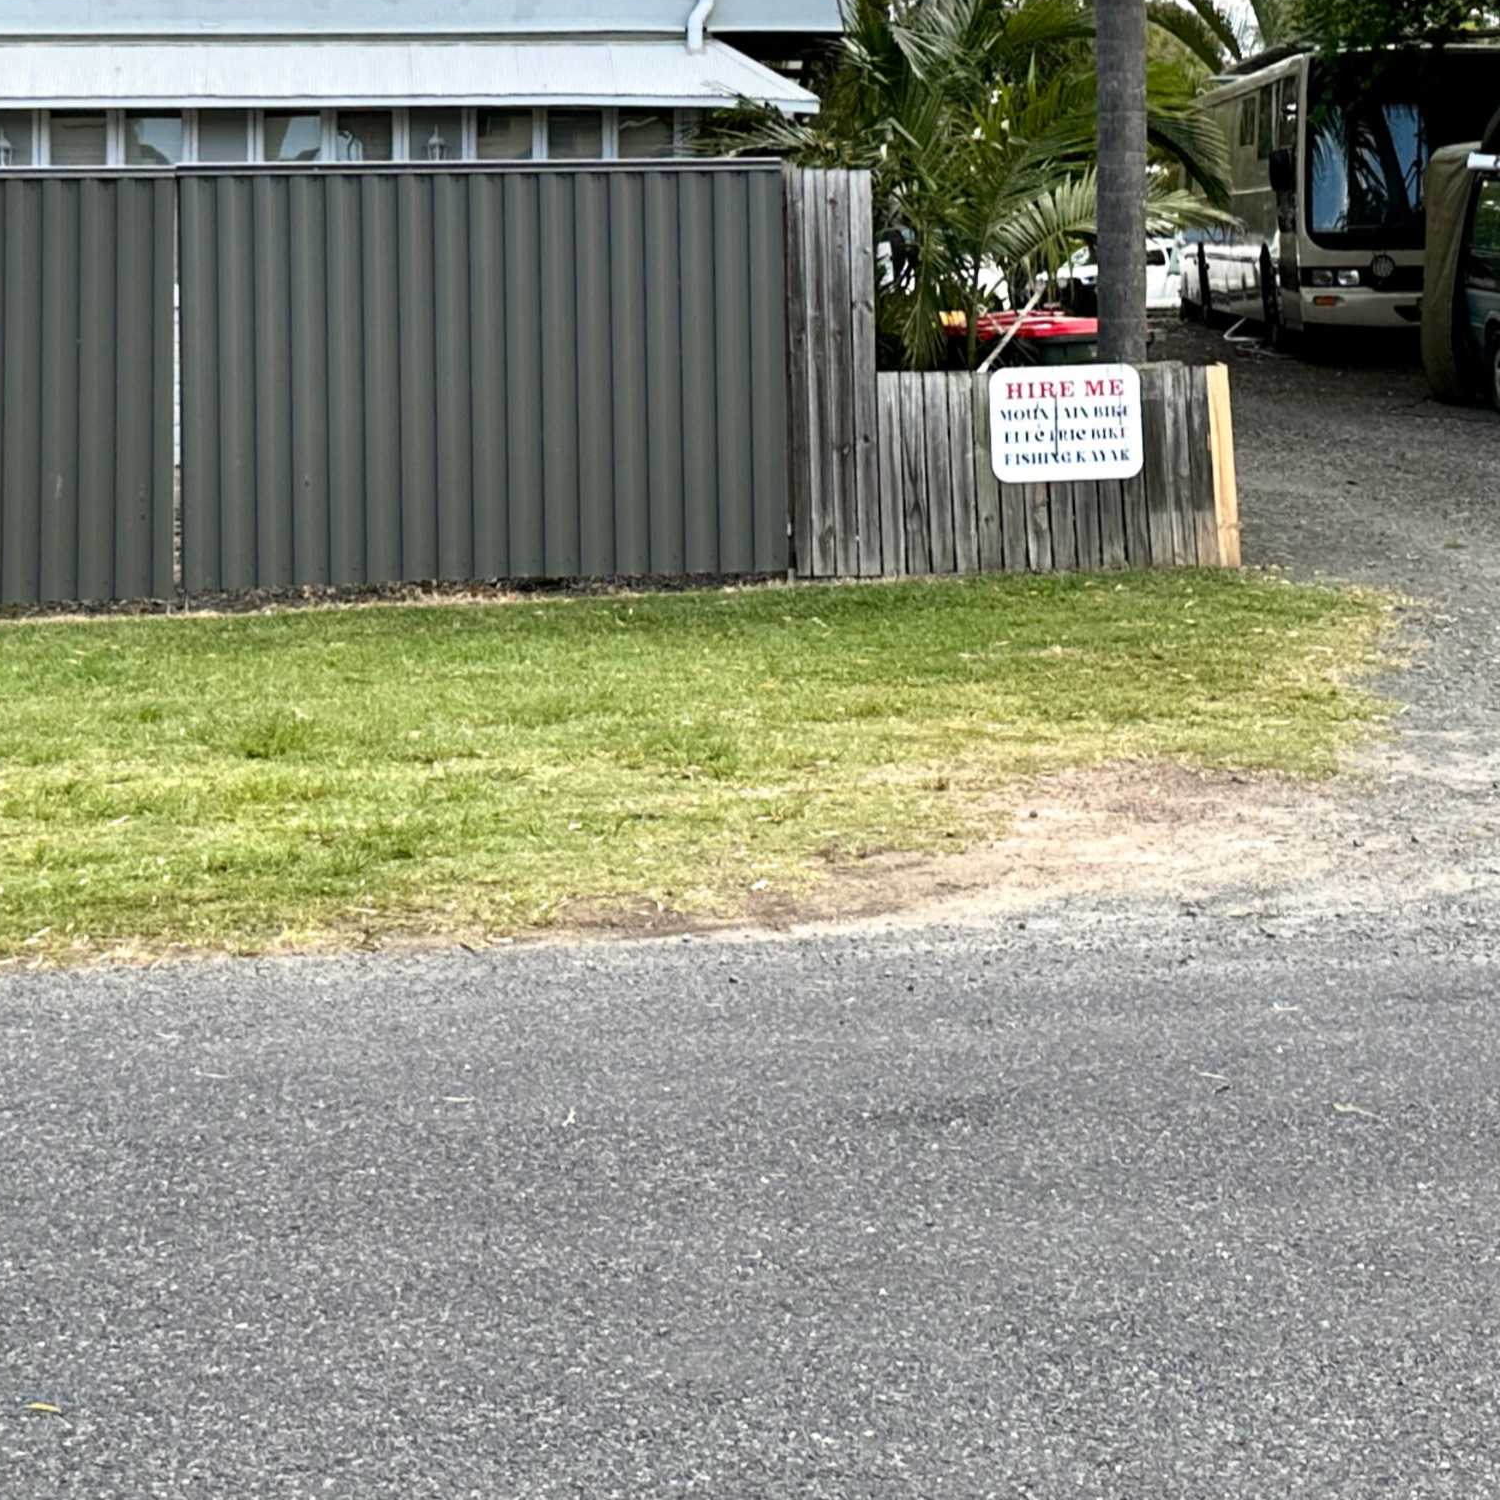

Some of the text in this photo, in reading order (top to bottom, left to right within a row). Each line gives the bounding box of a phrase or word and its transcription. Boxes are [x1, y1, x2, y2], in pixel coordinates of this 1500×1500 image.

[1005, 379, 1125, 399] HIRE ME
[1094, 405, 1129, 418] BIKE
[1004, 426, 1128, 443] ELECTRIC BIKE
[1004, 448, 1131, 466] FISHING KAYAK
